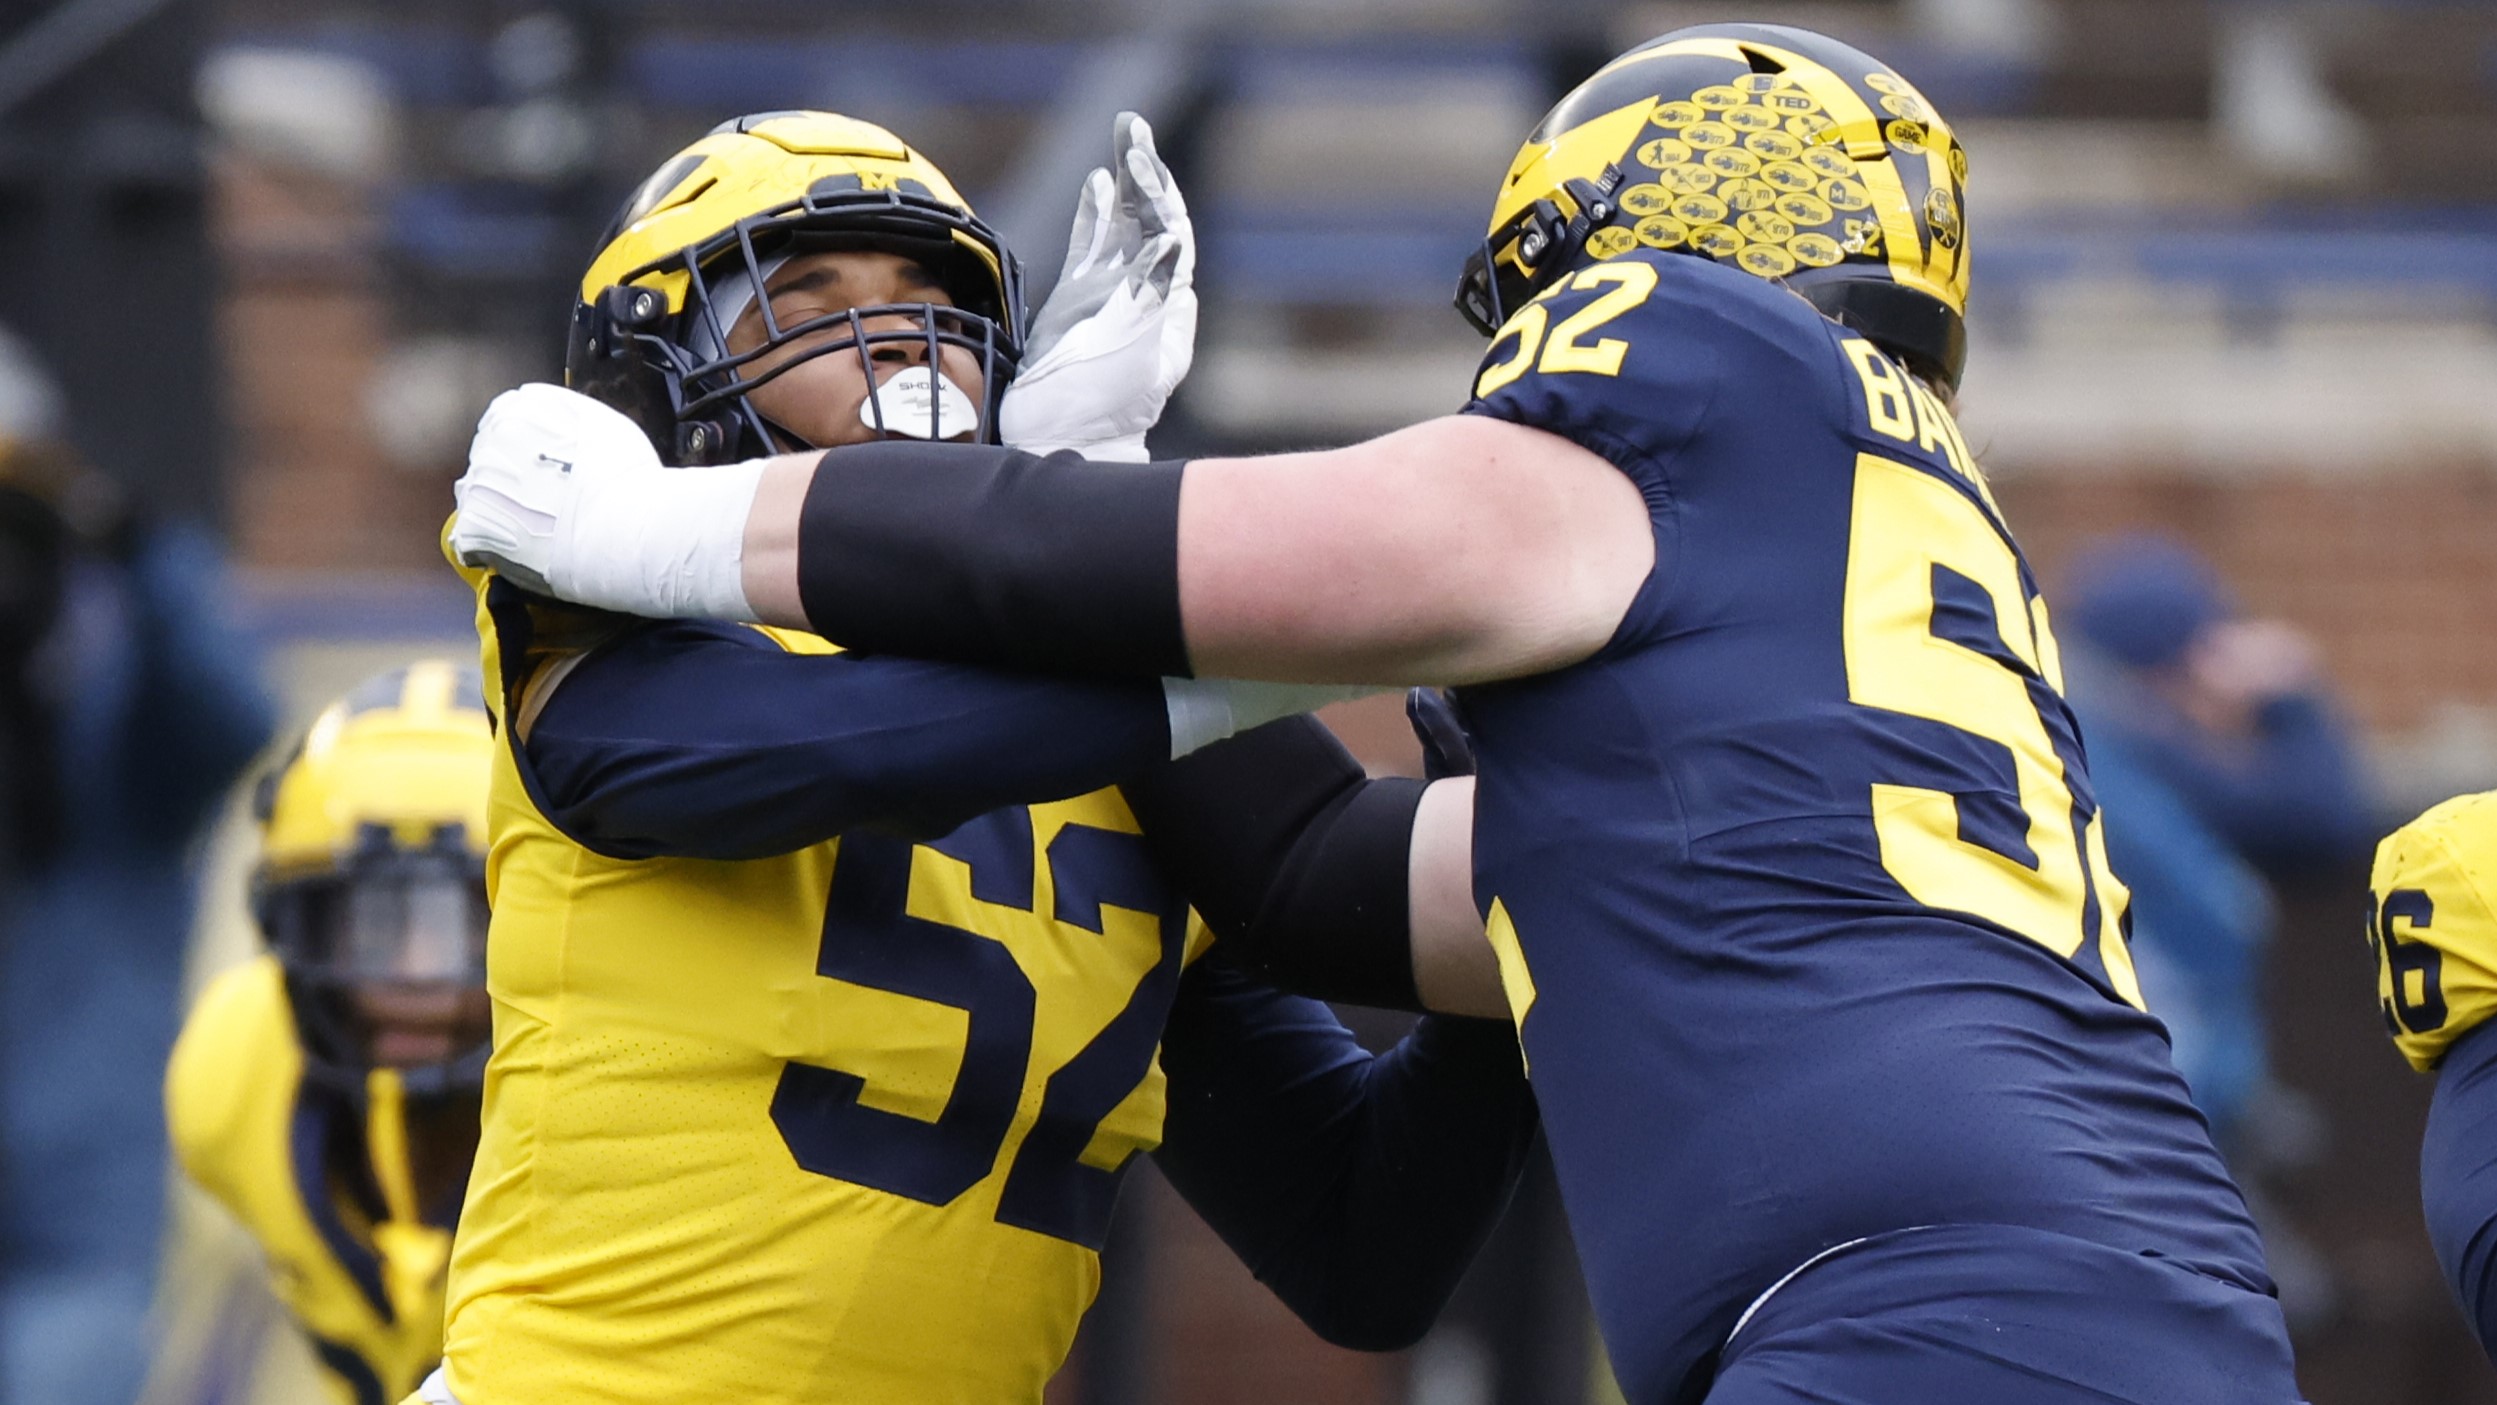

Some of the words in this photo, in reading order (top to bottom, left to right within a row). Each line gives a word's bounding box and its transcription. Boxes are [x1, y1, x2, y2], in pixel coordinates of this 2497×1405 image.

[1773, 95, 1810, 109] TED
[1895, 126, 1922, 145] GAME
[1476, 261, 1659, 400] 52
[769, 803, 1187, 1253] 52
